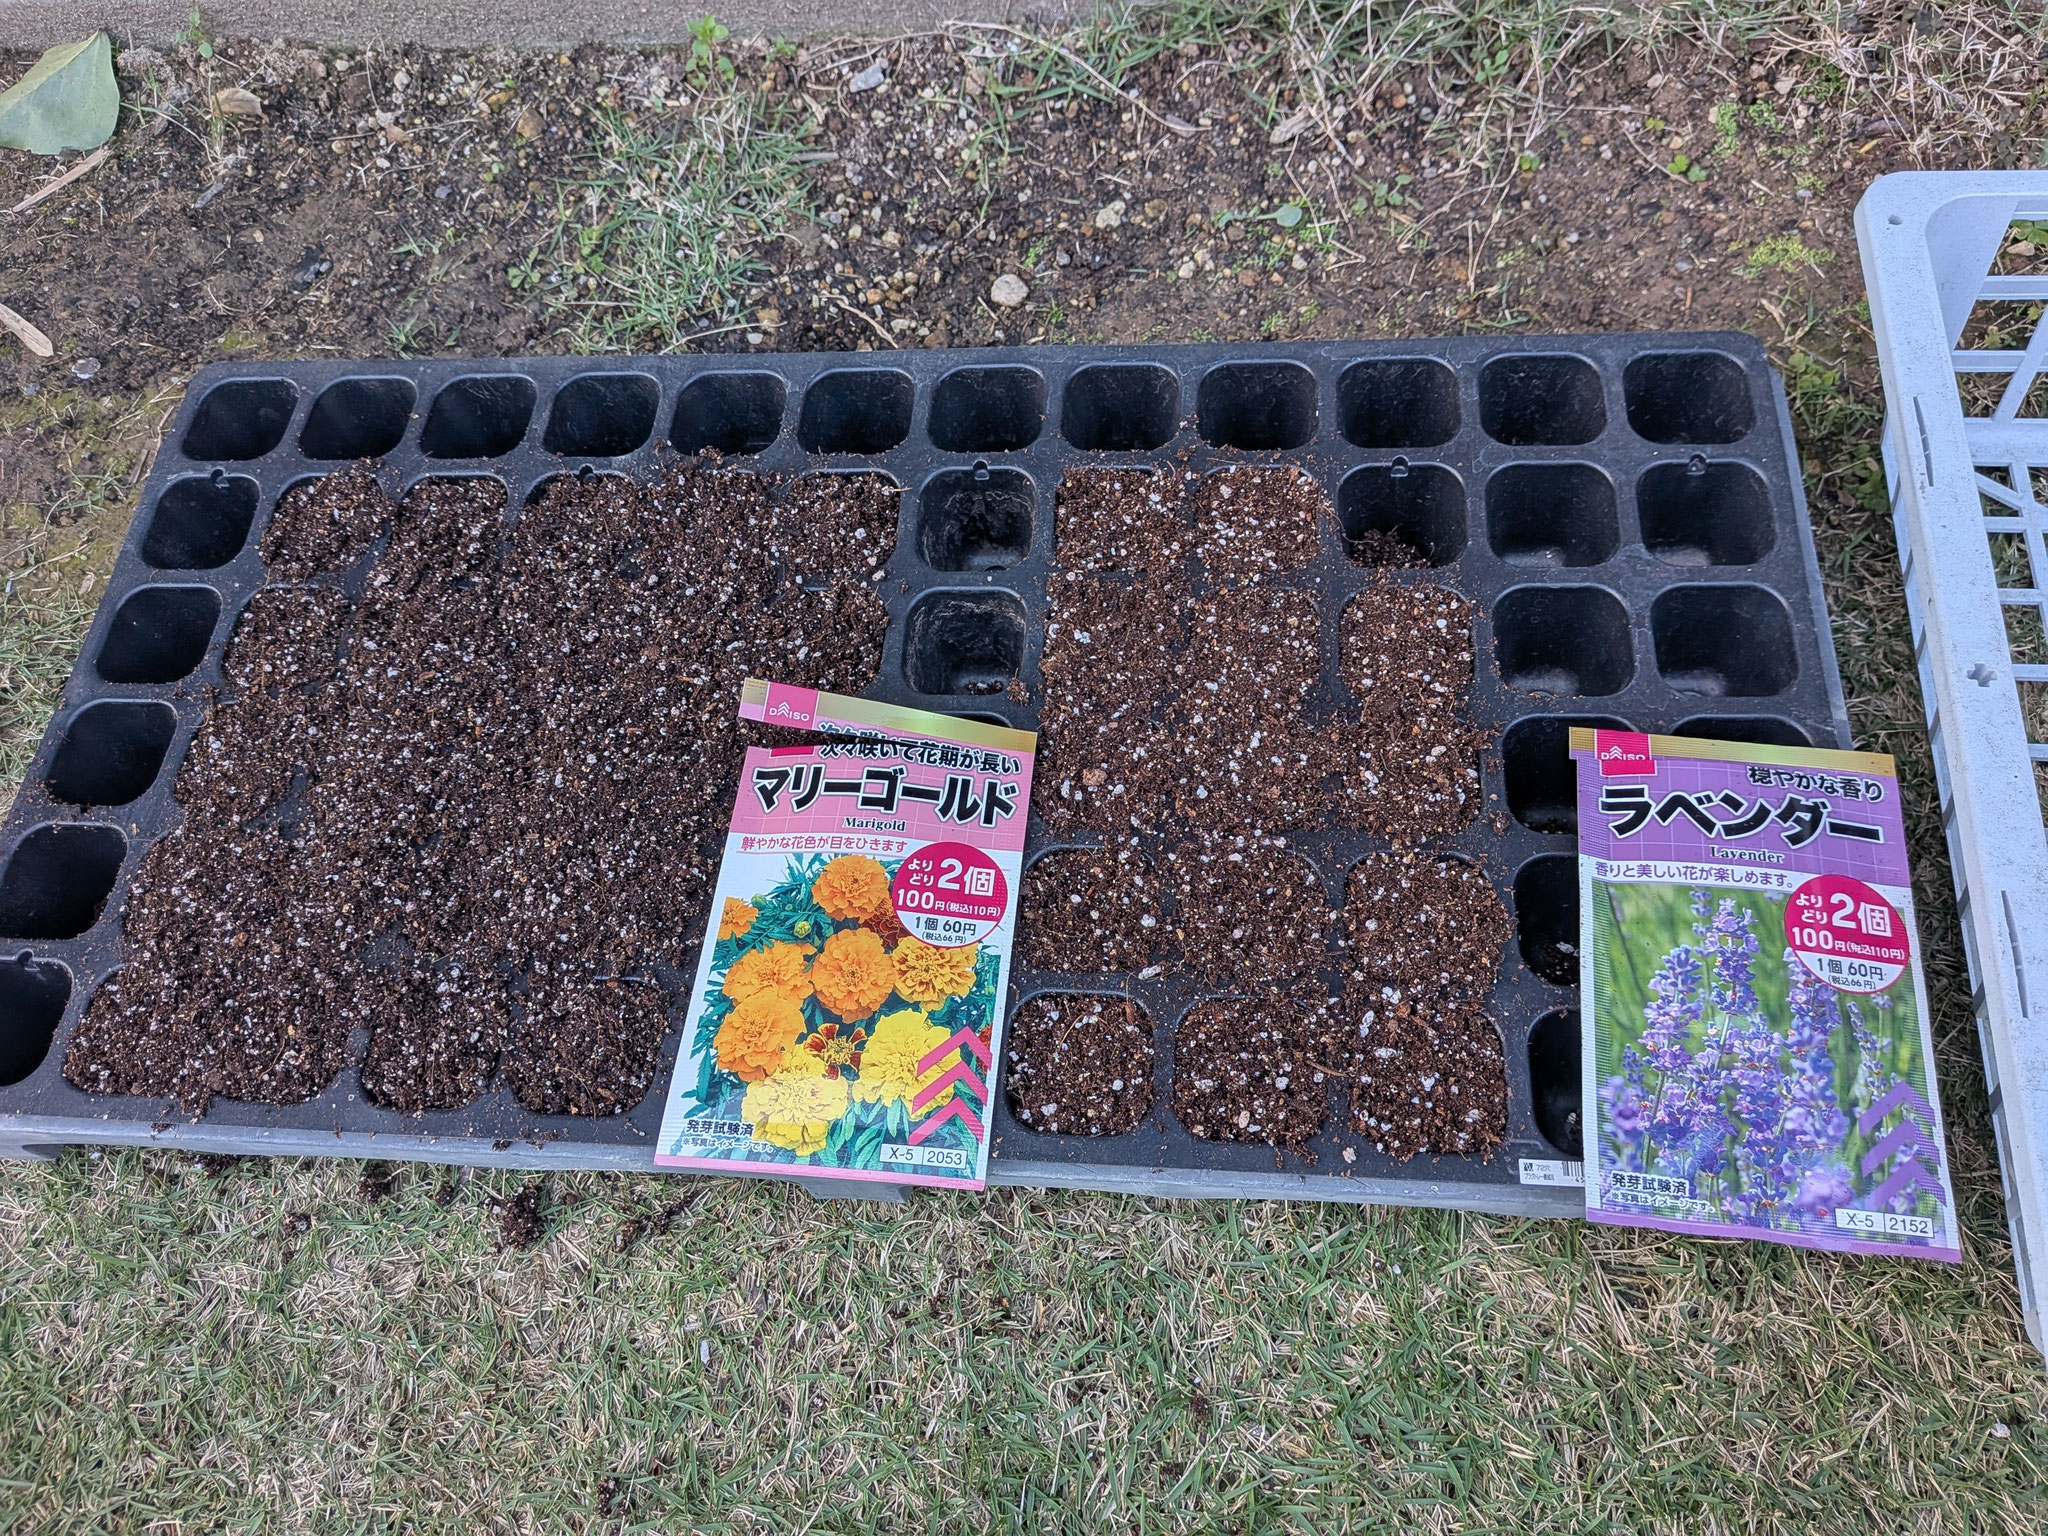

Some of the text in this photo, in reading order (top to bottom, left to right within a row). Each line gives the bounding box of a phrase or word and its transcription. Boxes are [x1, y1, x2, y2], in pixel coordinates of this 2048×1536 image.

[1747, 765, 1884, 803] 穏やかな香り
[753, 764, 1020, 828] マリーゴールド
[843, 816, 907, 833] Marigold
[1600, 785, 1884, 849] ラベンダー
[741, 836, 908, 853] 鮮やかな花色が目をひきます
[908, 858, 933, 872] より
[1710, 846, 1784, 864] Lavender
[909, 873, 935, 887] どり
[937, 858, 996, 897] 2個
[1595, 861, 1794, 888] 香りと美しい花が楽しめます。
[1796, 893, 1823, 908] より
[1801, 909, 1828, 924] どり
[1829, 892, 1892, 937] 2個
[915, 916, 977, 936] 1個 60円
[1817, 958, 1884, 981] 1個 60円
[686, 1119, 755, 1137] 発芽試験済
[889, 1146, 963, 1166] X-5 2053
[1611, 1172, 1688, 1195] 発芽試験済
[1846, 1213, 1929, 1234] X-5 2152
